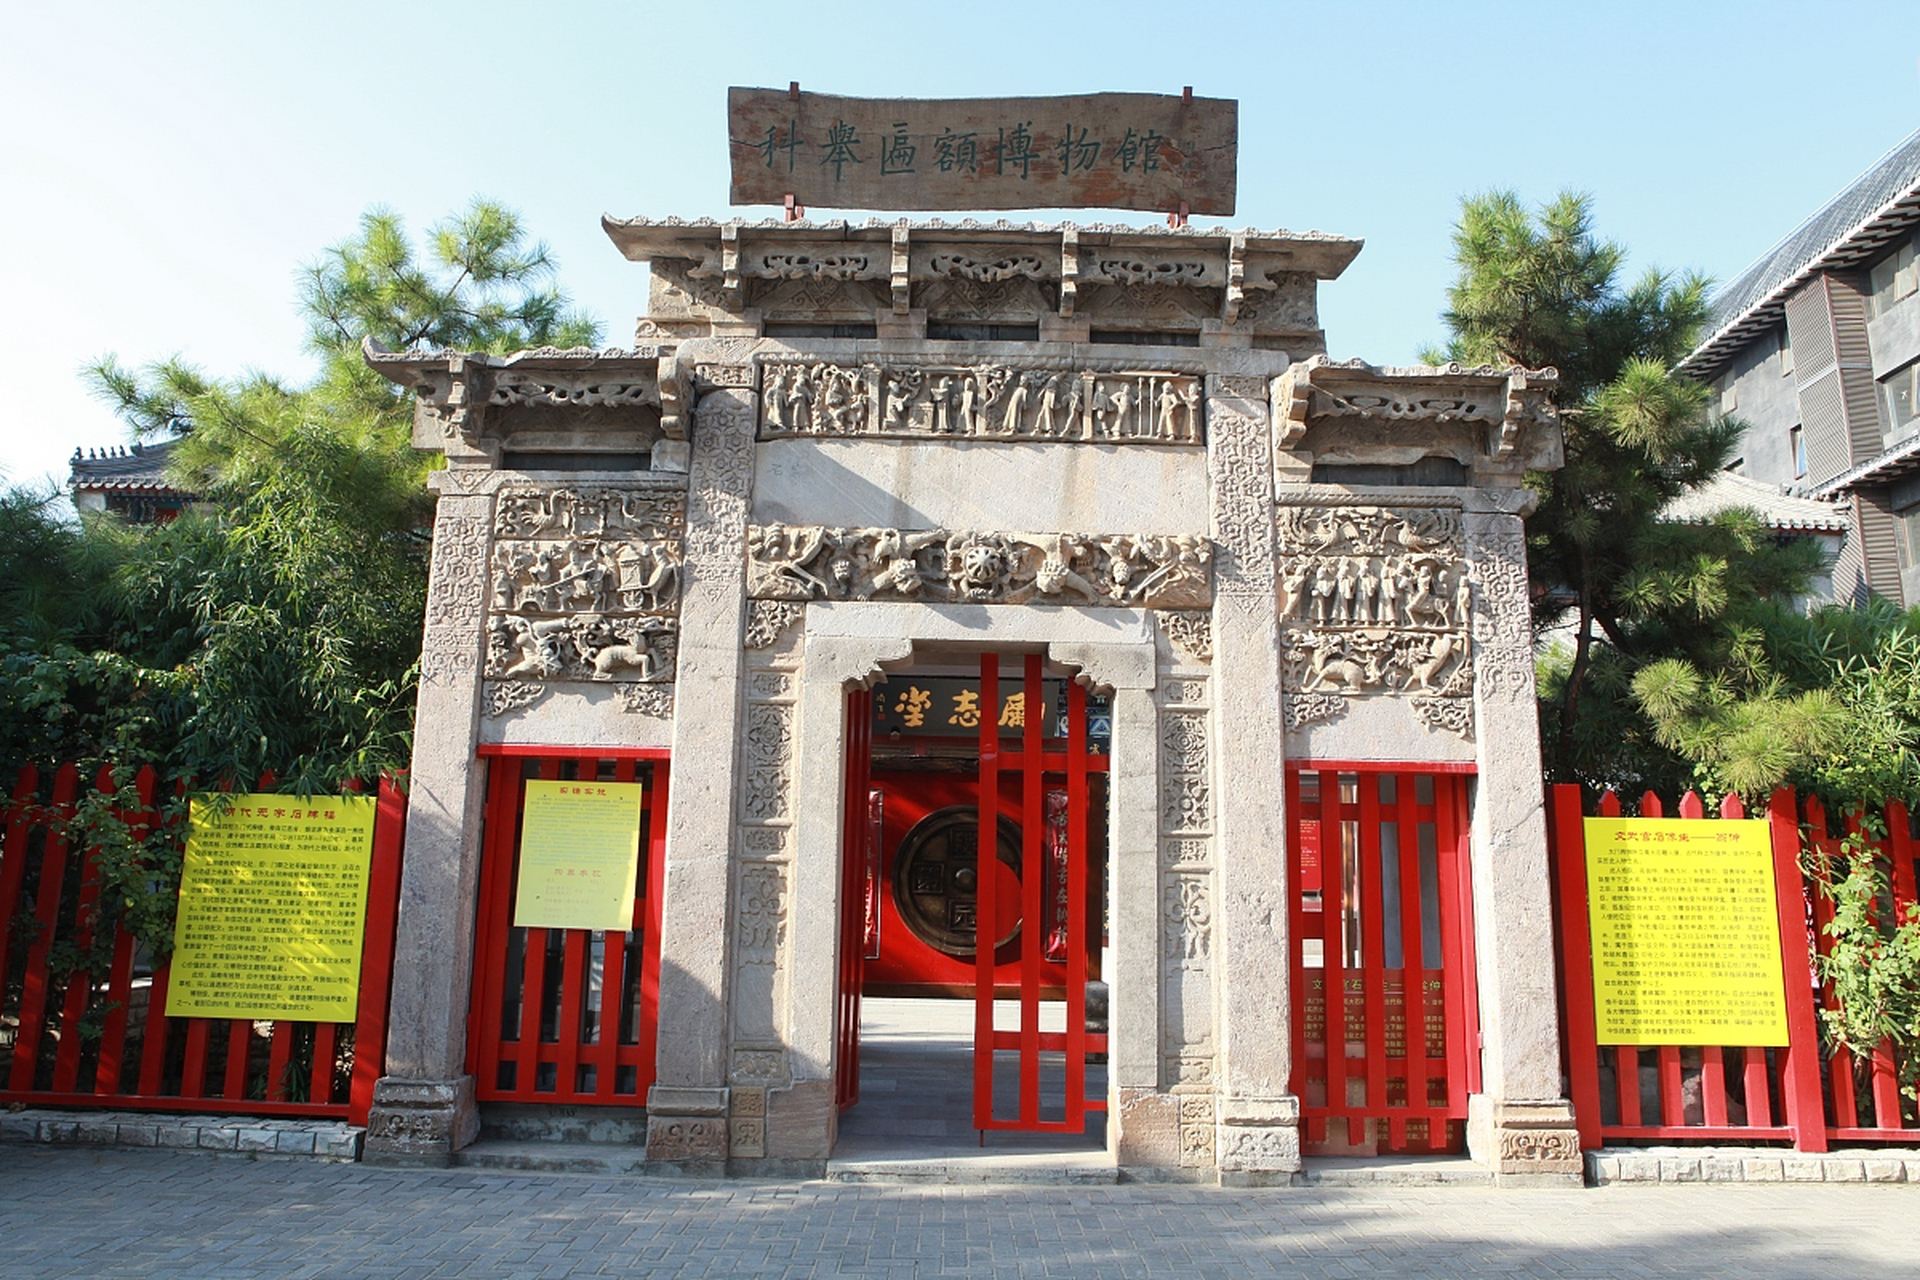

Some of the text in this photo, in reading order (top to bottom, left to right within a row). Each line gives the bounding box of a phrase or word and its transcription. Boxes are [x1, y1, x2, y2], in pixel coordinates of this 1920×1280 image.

[759, 120, 1164, 181] 科舉匾額博物館
